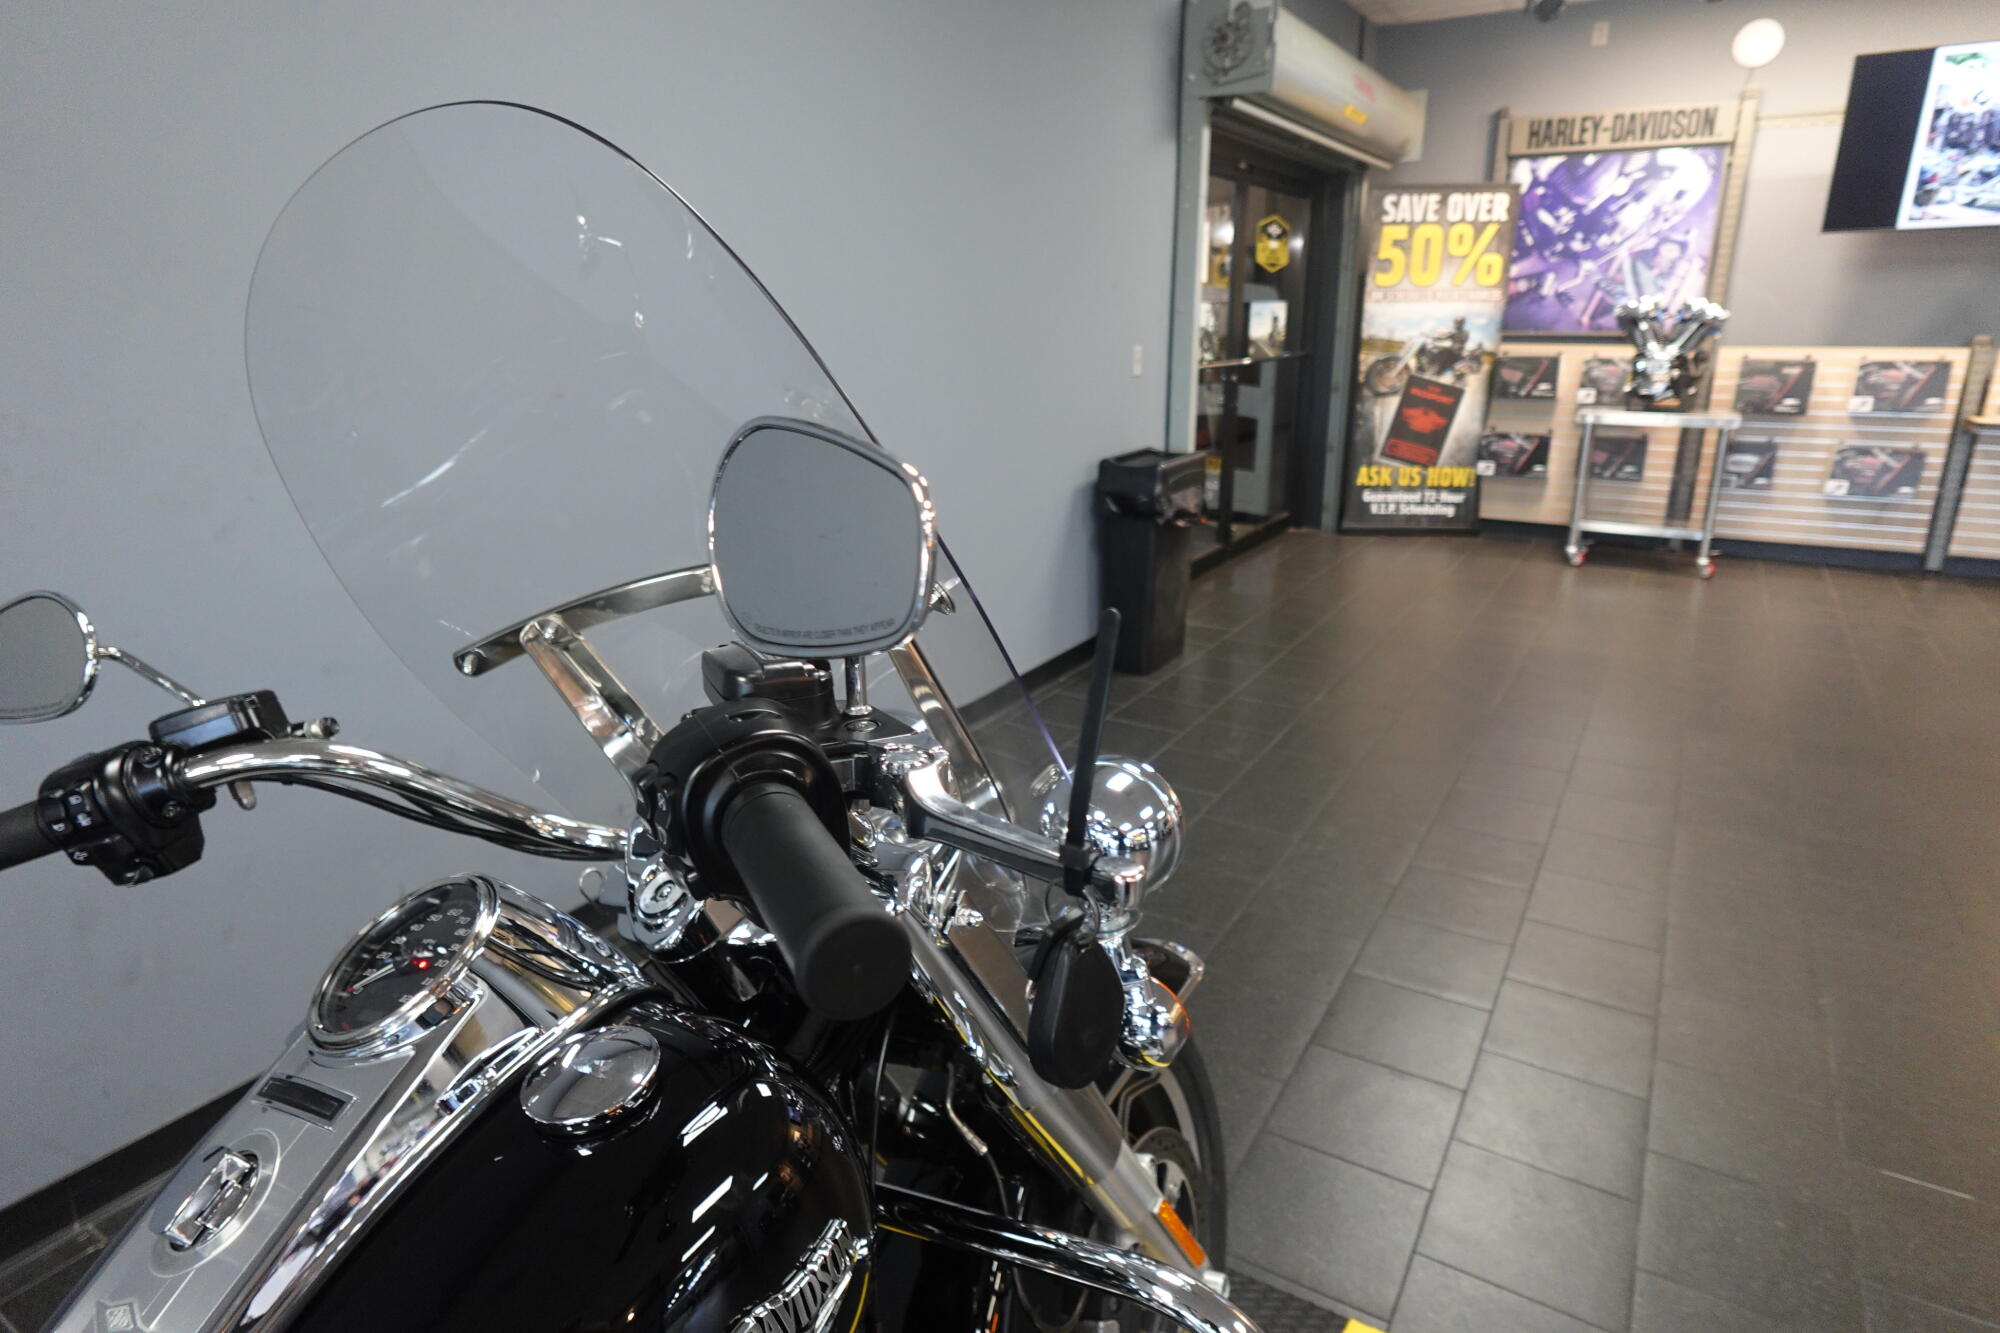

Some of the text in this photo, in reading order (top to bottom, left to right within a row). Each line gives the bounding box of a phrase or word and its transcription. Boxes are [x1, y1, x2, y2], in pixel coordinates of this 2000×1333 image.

[1528, 107, 1719, 149] HARLEY-DAVIDSON
[1381, 192, 1511, 223] SAVE OVER
[1374, 223, 1505, 288] 50%
[1356, 465, 1393, 487] ASK
[1397, 465, 1422, 487] US
